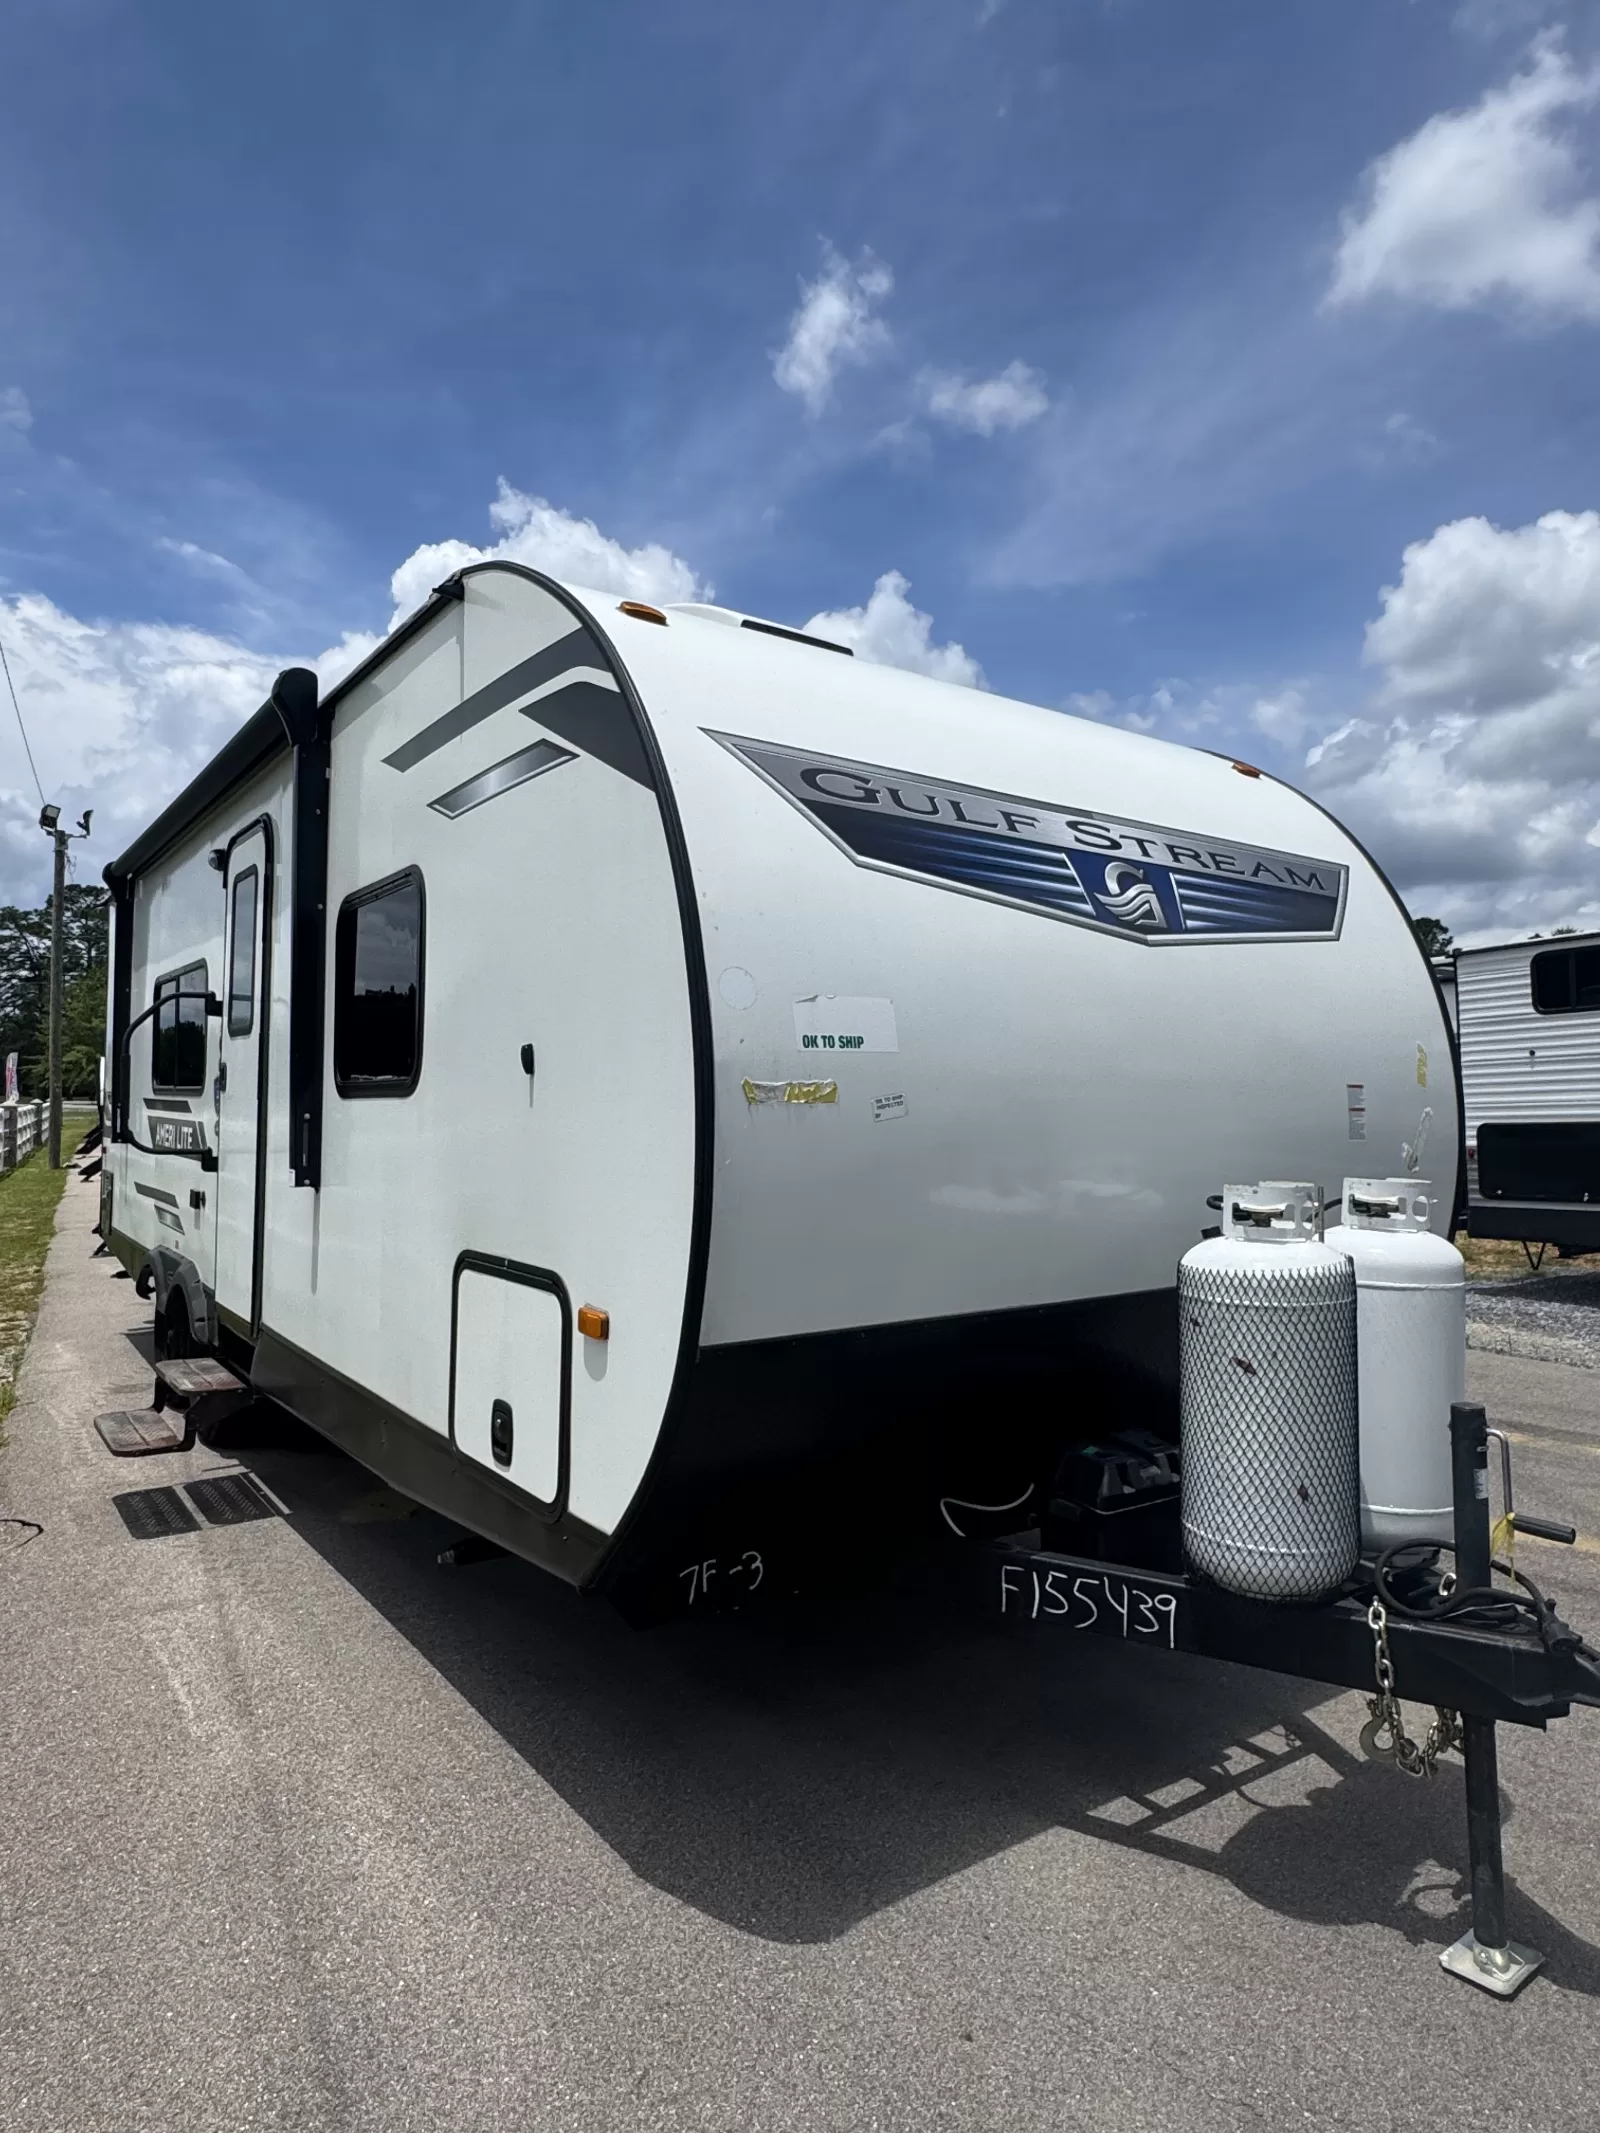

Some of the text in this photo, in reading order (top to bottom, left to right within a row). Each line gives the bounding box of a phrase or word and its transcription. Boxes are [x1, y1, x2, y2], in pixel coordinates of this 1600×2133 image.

[799, 766, 1327, 891] GULF STREAM
[802, 1034, 864, 1049] OK TO SHIP
